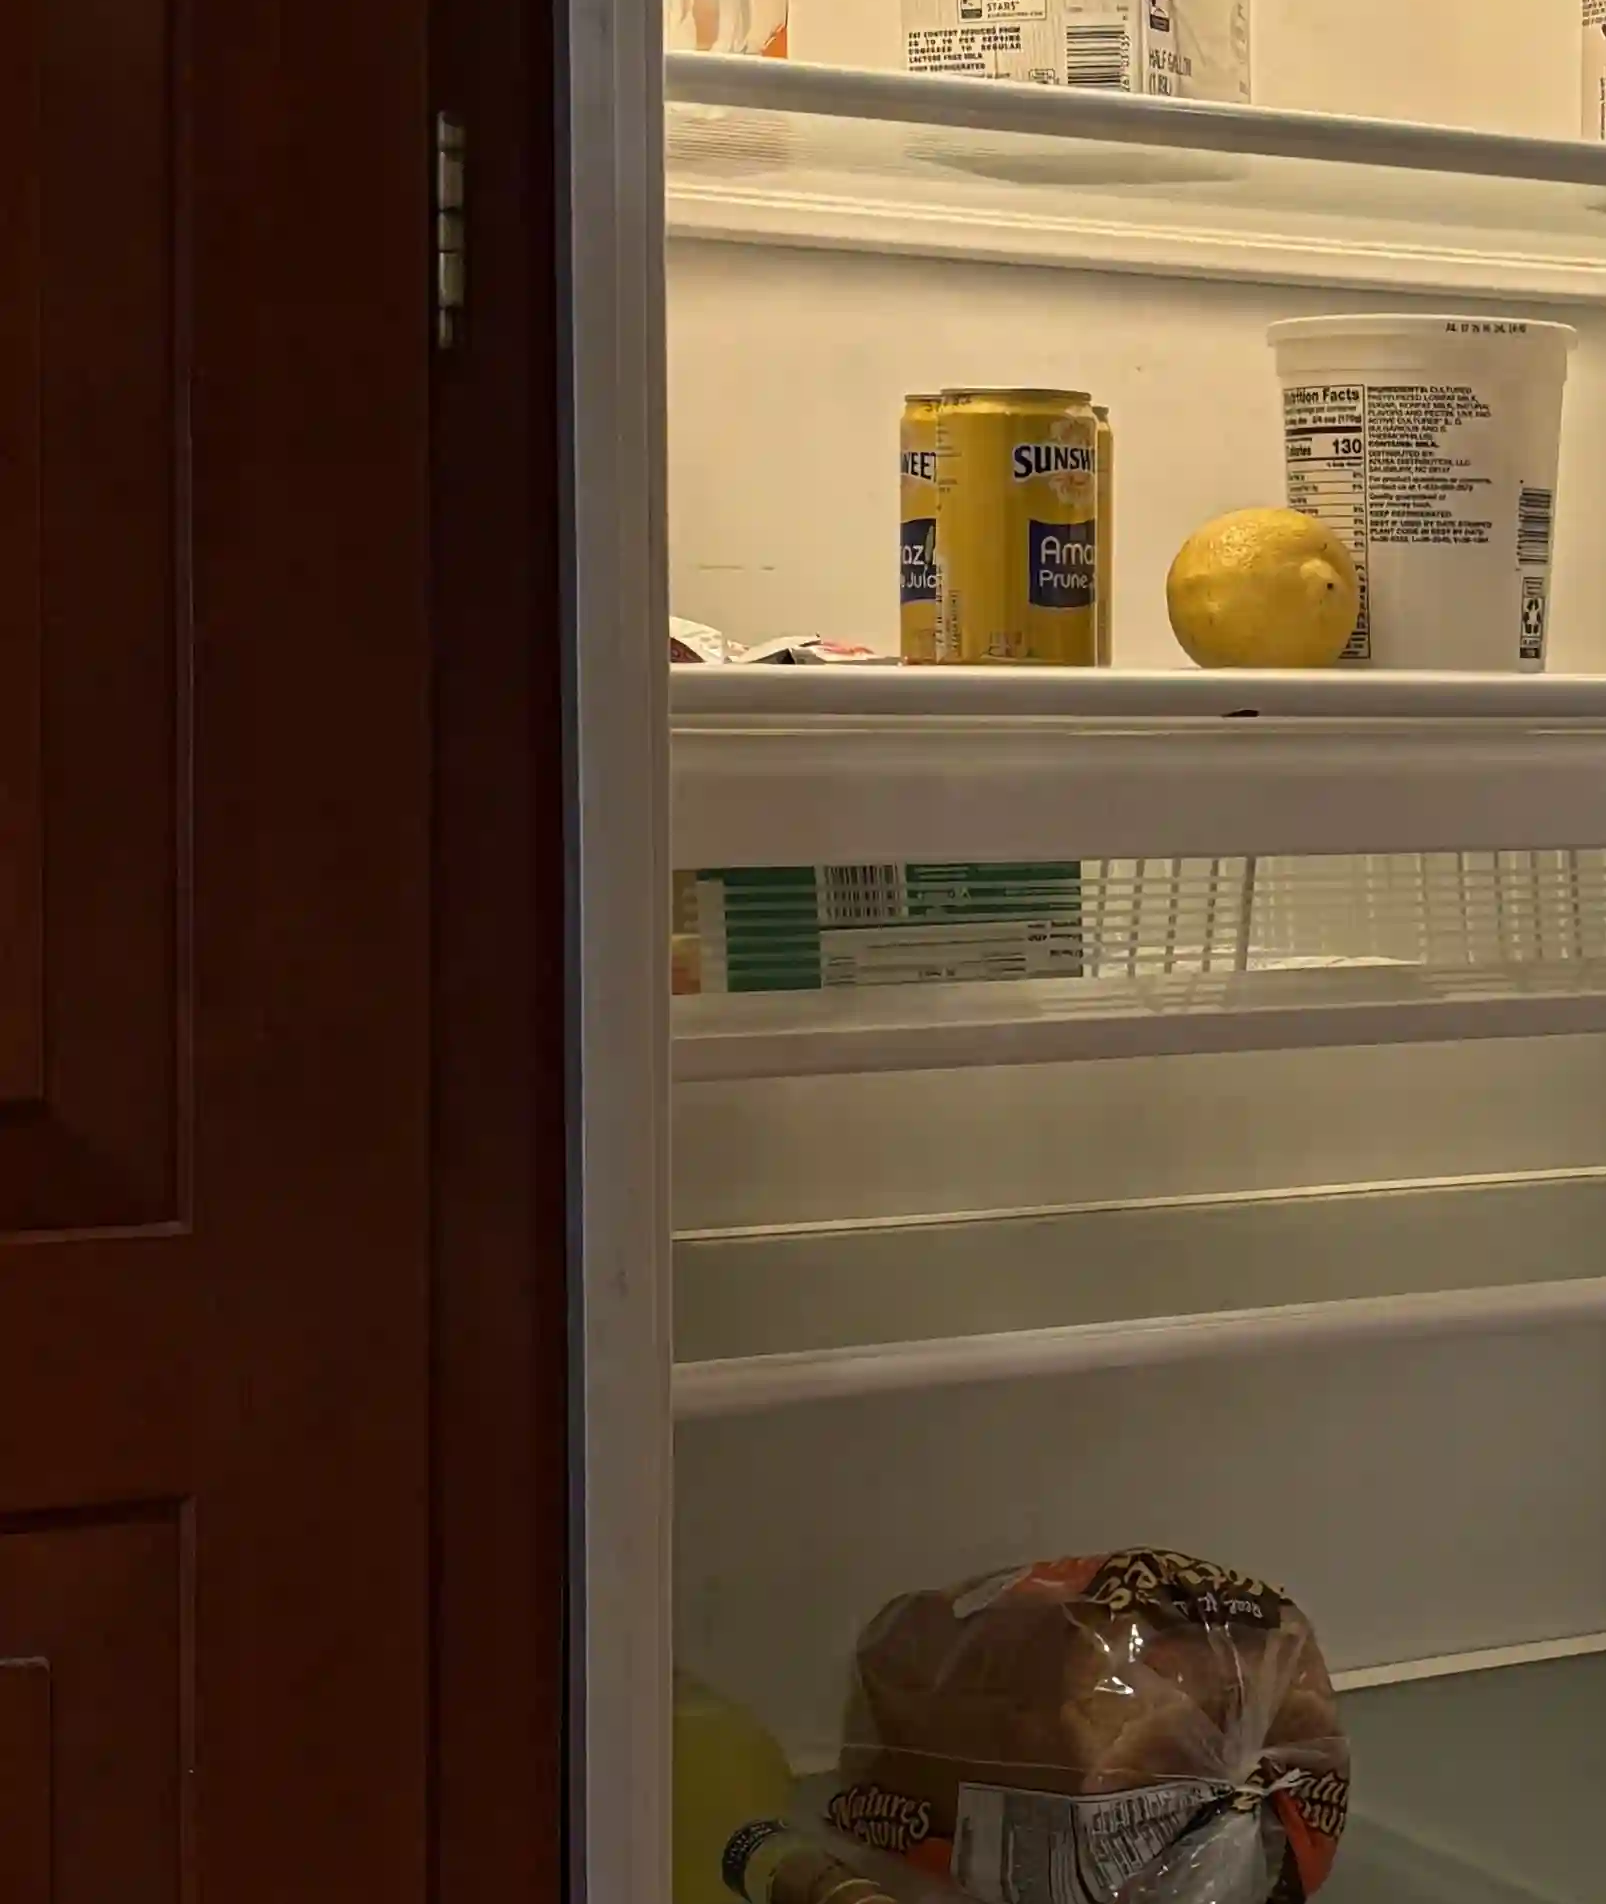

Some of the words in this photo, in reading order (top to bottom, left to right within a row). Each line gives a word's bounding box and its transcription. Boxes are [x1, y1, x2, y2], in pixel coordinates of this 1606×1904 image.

[1322, 387, 1360, 401] Facts
[1332, 438, 1362, 455] 130
[1039, 569, 1089, 589] Prune
